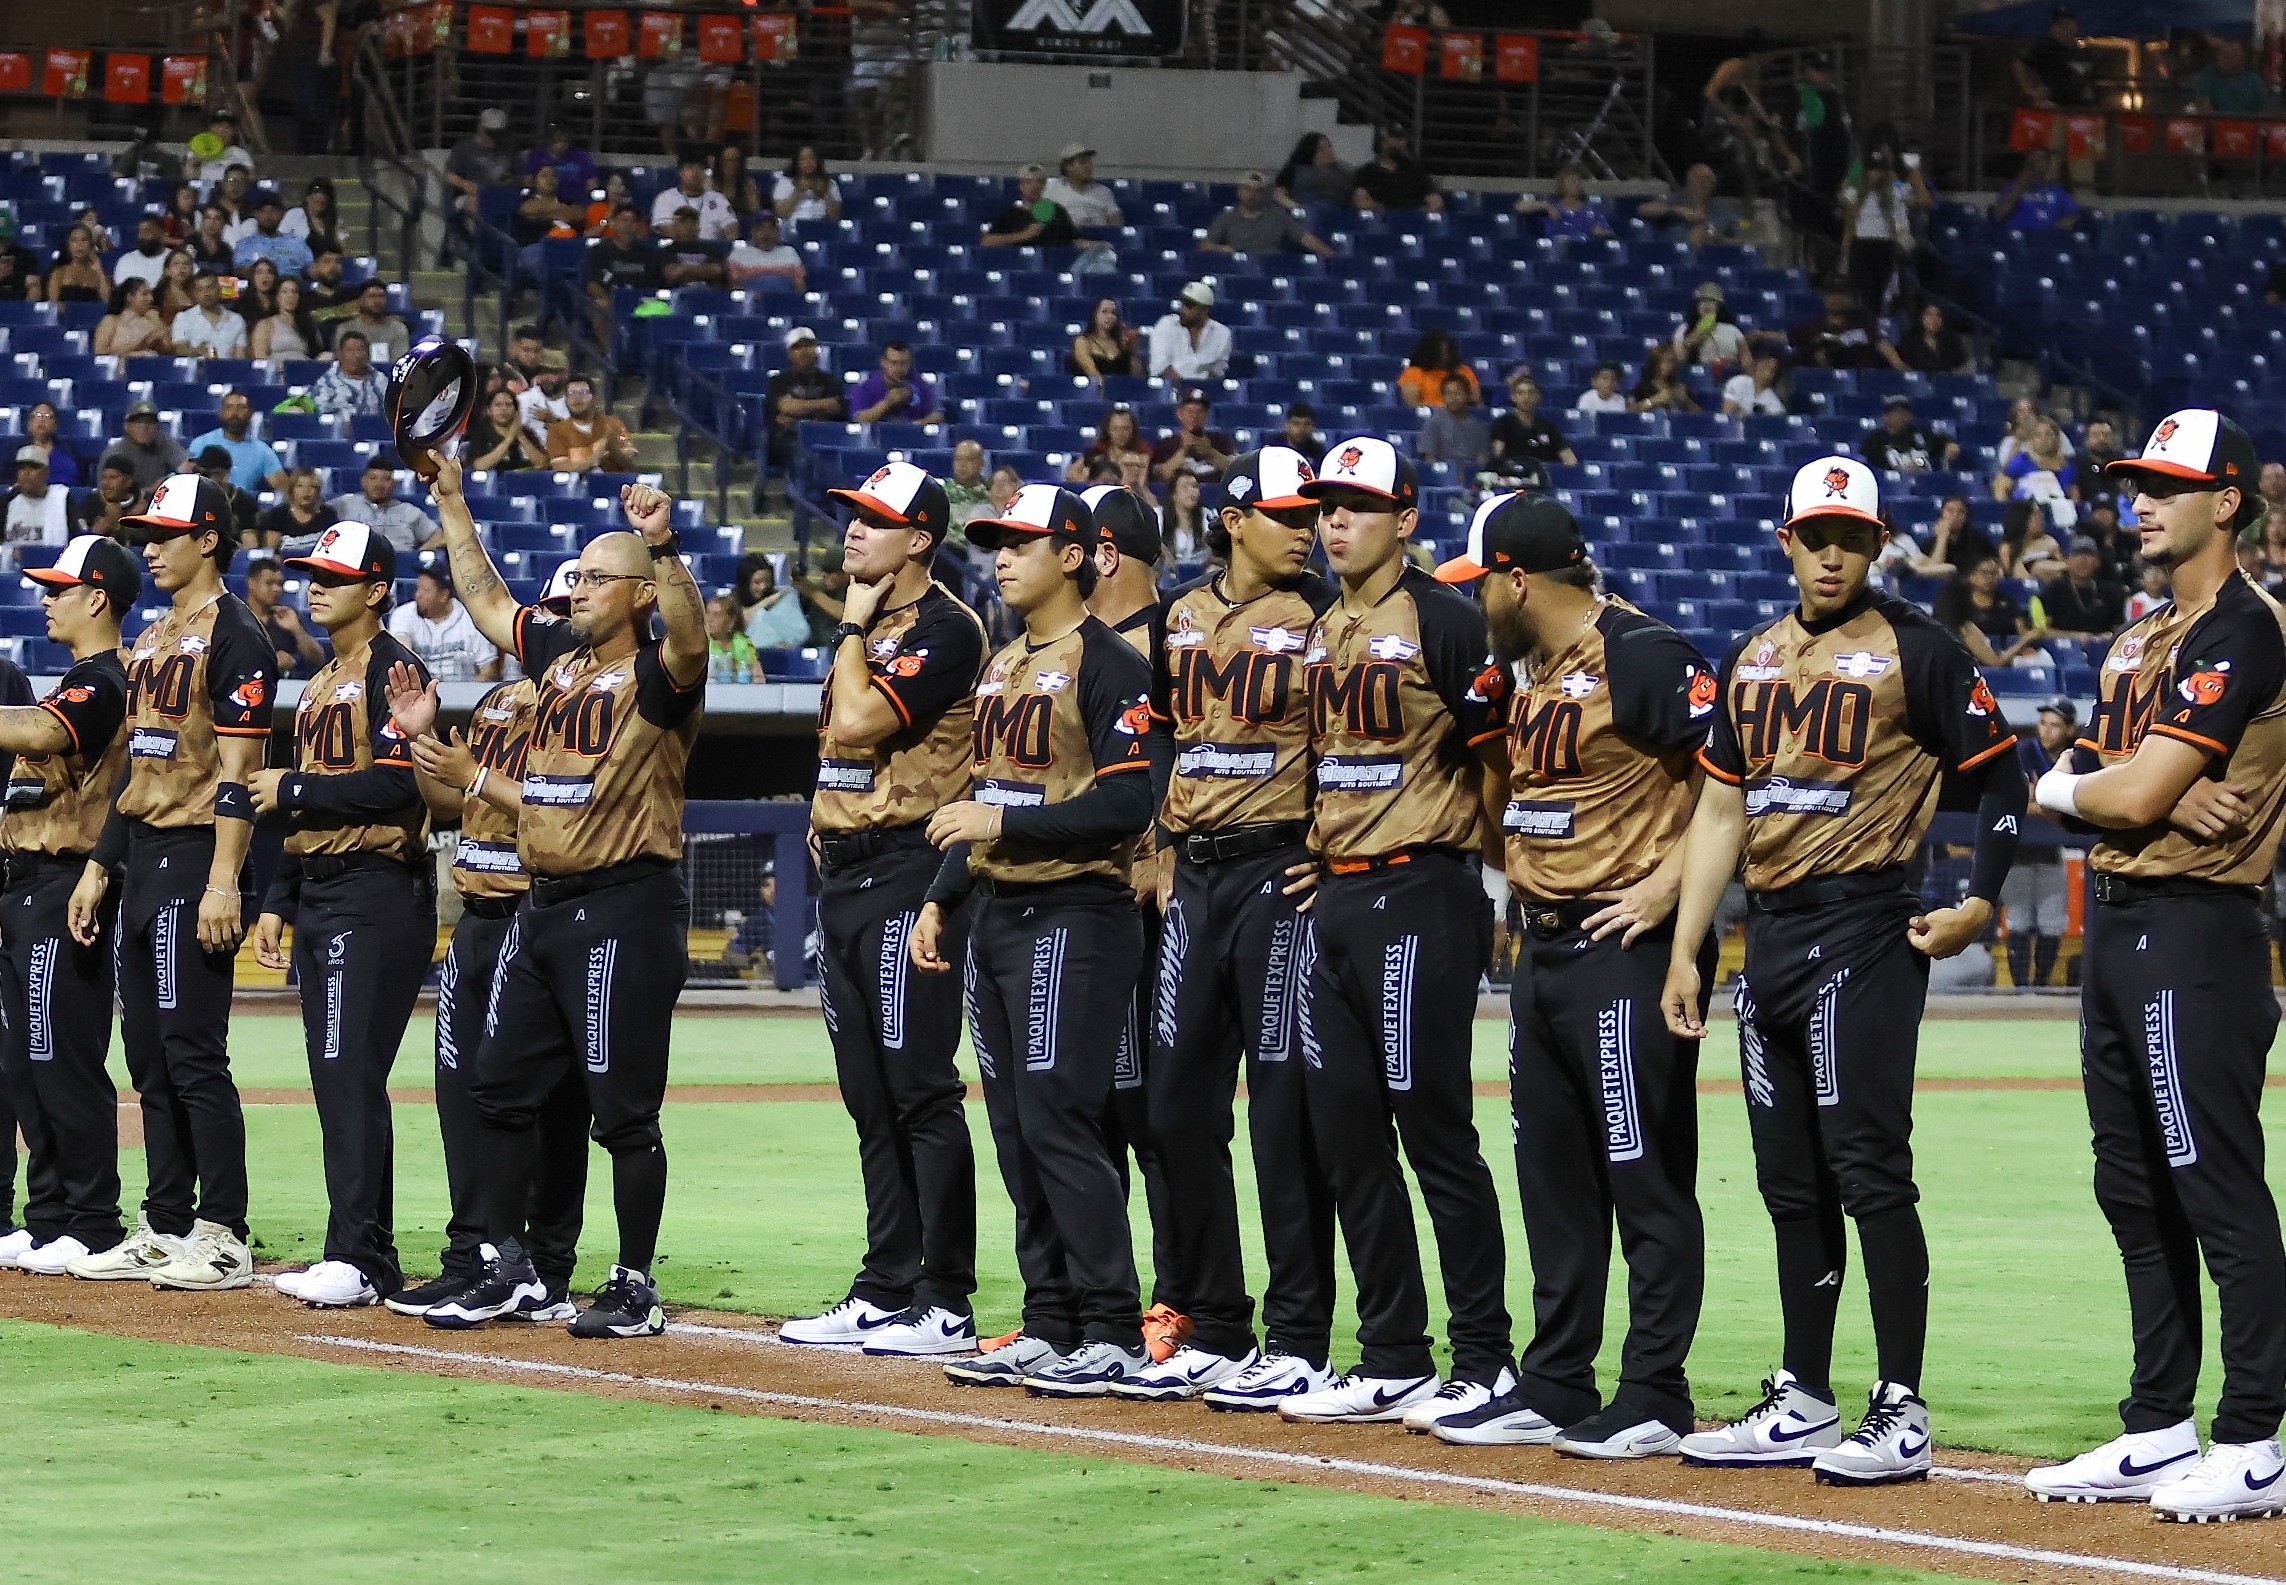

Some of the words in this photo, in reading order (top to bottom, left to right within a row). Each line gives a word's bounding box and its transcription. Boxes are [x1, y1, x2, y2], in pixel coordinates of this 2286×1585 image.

[1167, 647, 1293, 725] HMO
[1734, 679, 1873, 769] HMO
[1358, 779, 1393, 788] BOUTIQUE
[1803, 804, 1839, 814] BOUTIQUE
[29, 943, 47, 1047] PAQUETEXPRESS
[325, 976, 336, 1049] PAQUETEXPRESS
[586, 946, 605, 1058] PAQUETEXPRESS
[880, 919, 901, 1034] PAQUETEXPRESS
[1028, 936, 1053, 1055] PAQUETEXPRESS
[1158, 897, 1190, 1048] Caliente
[1261, 919, 1293, 1044] PAQUETEXPRESS
[1383, 944, 1403, 1073] PAQUETEXPRESS
[1598, 1011, 1628, 1146] PAQUETEXPRESS
[2144, 1003, 2181, 1148] PAQUETEXPRESS
